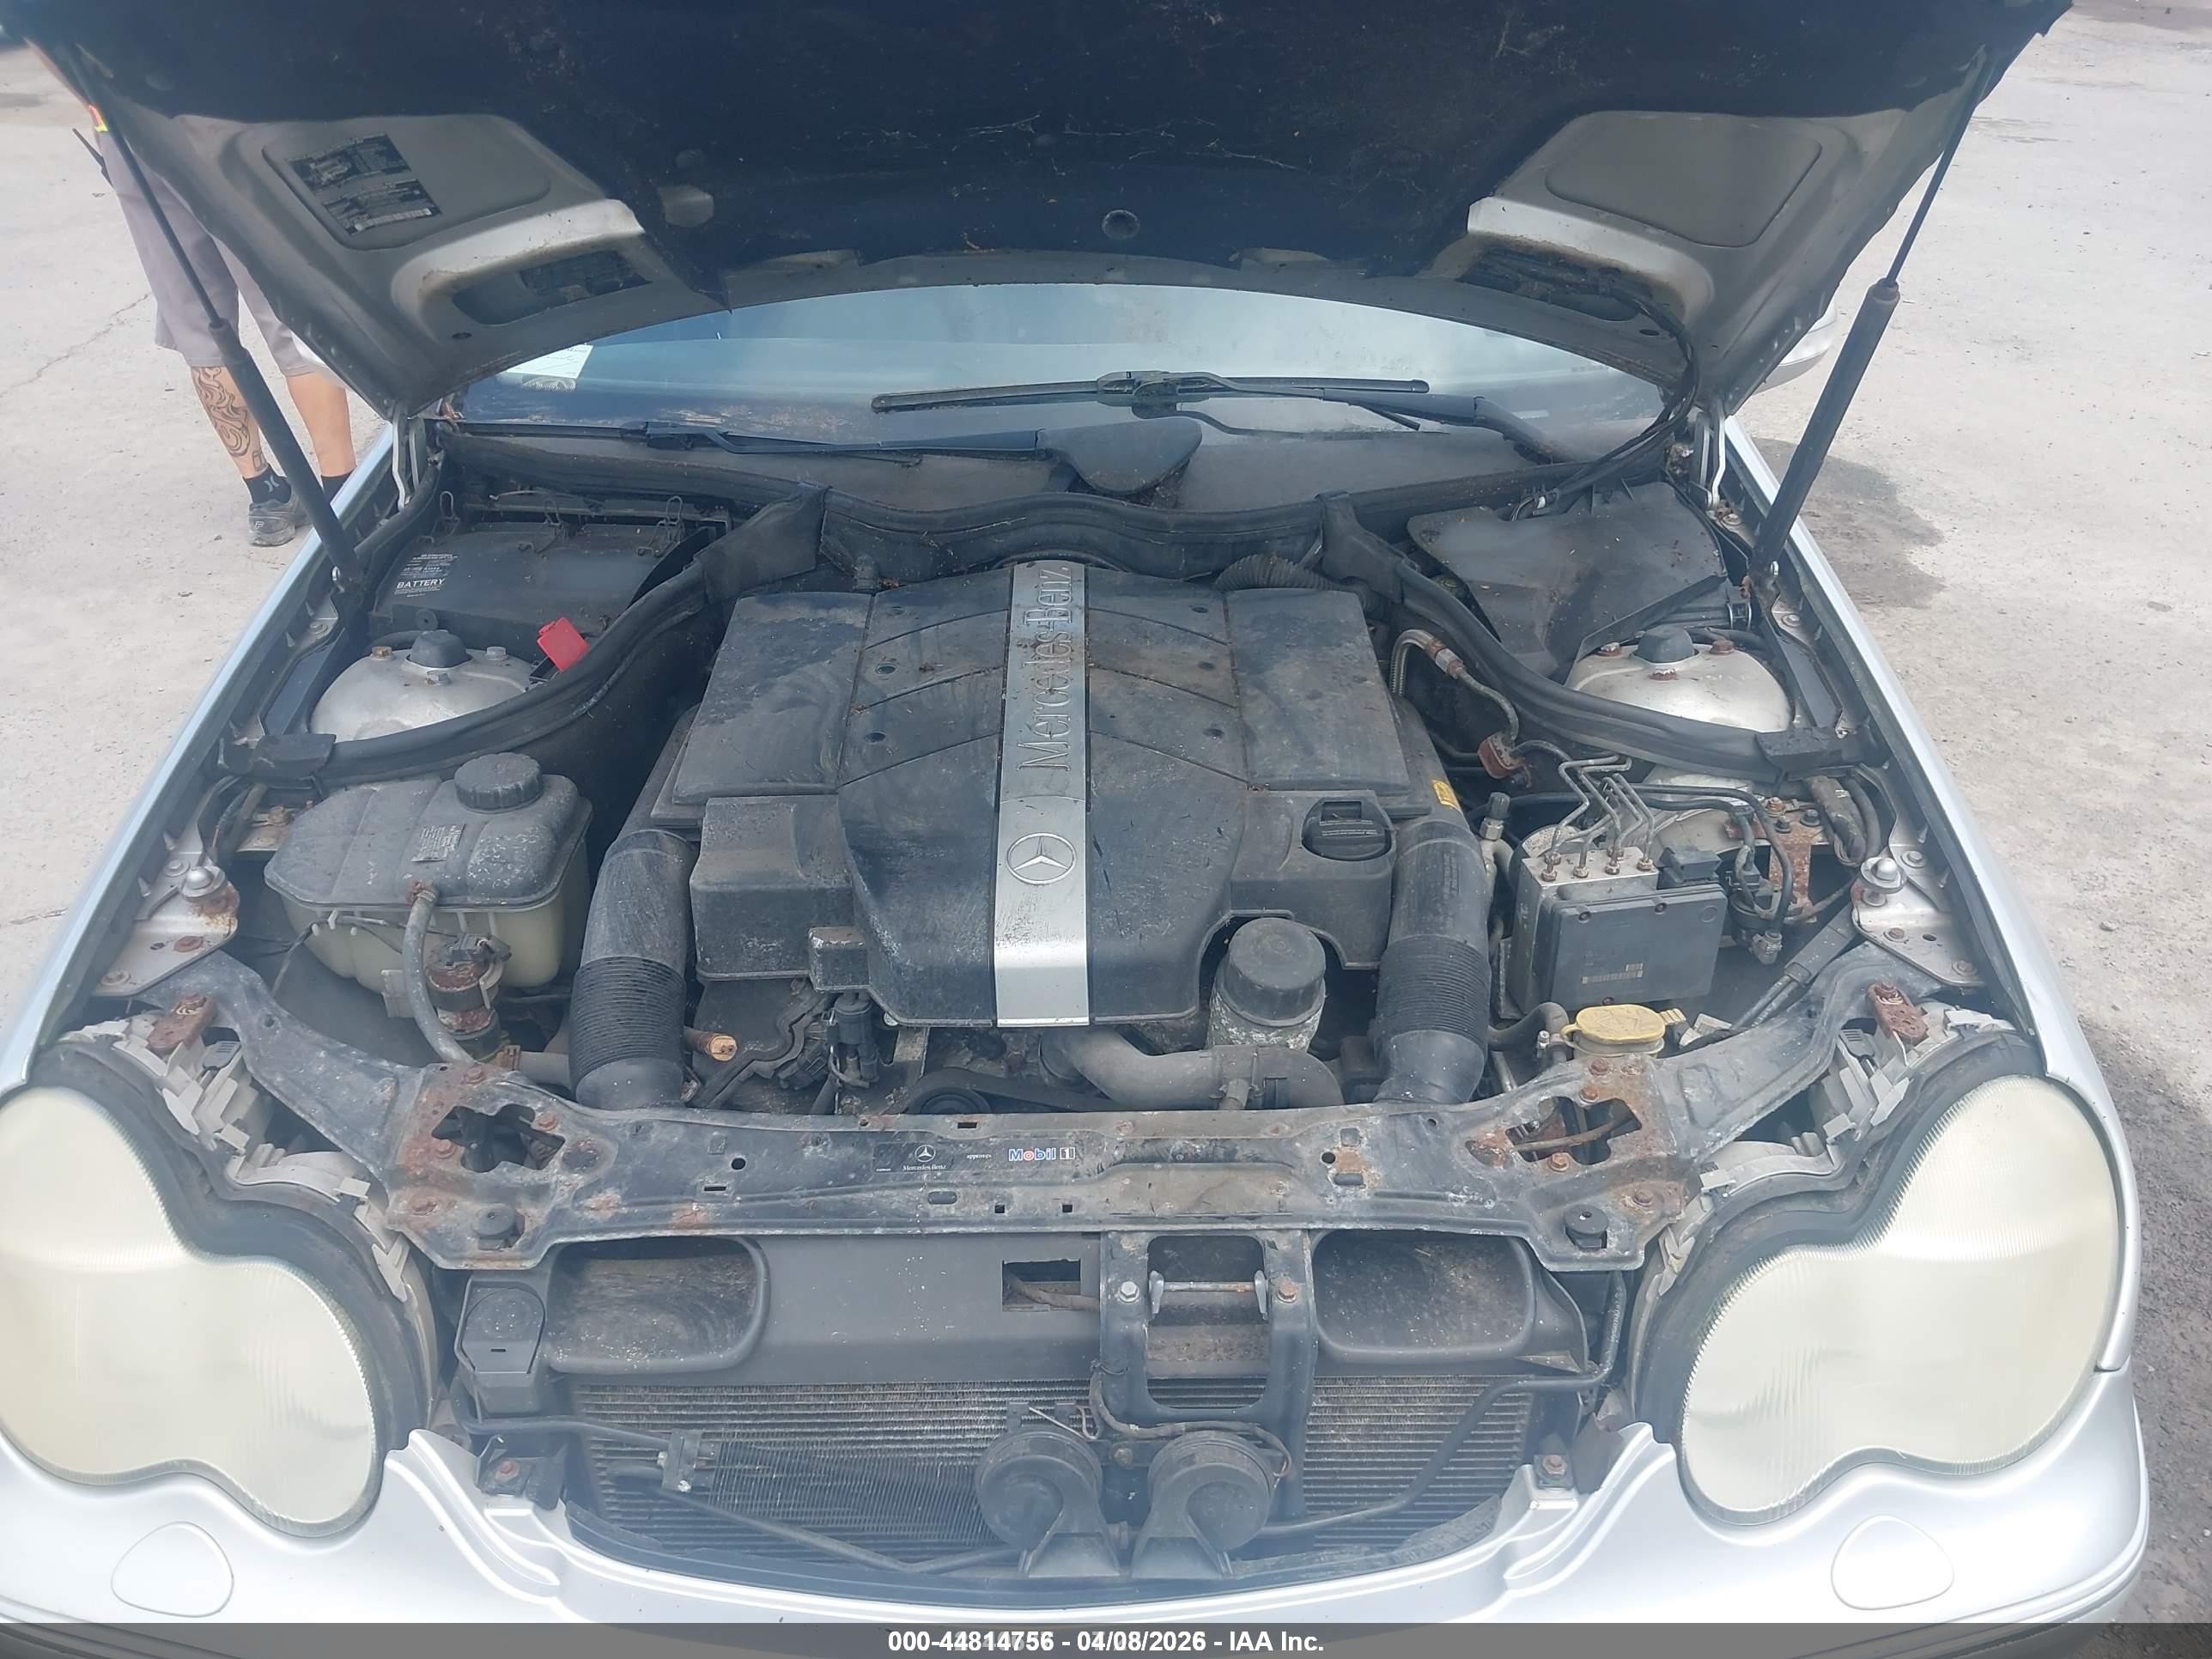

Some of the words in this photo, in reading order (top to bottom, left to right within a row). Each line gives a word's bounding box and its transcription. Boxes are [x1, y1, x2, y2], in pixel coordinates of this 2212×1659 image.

[397, 578, 446, 589] BATTERY
[1017, 567, 1073, 771] Mercedes-Benz
[1008, 1147, 1057, 1162] Mobil
